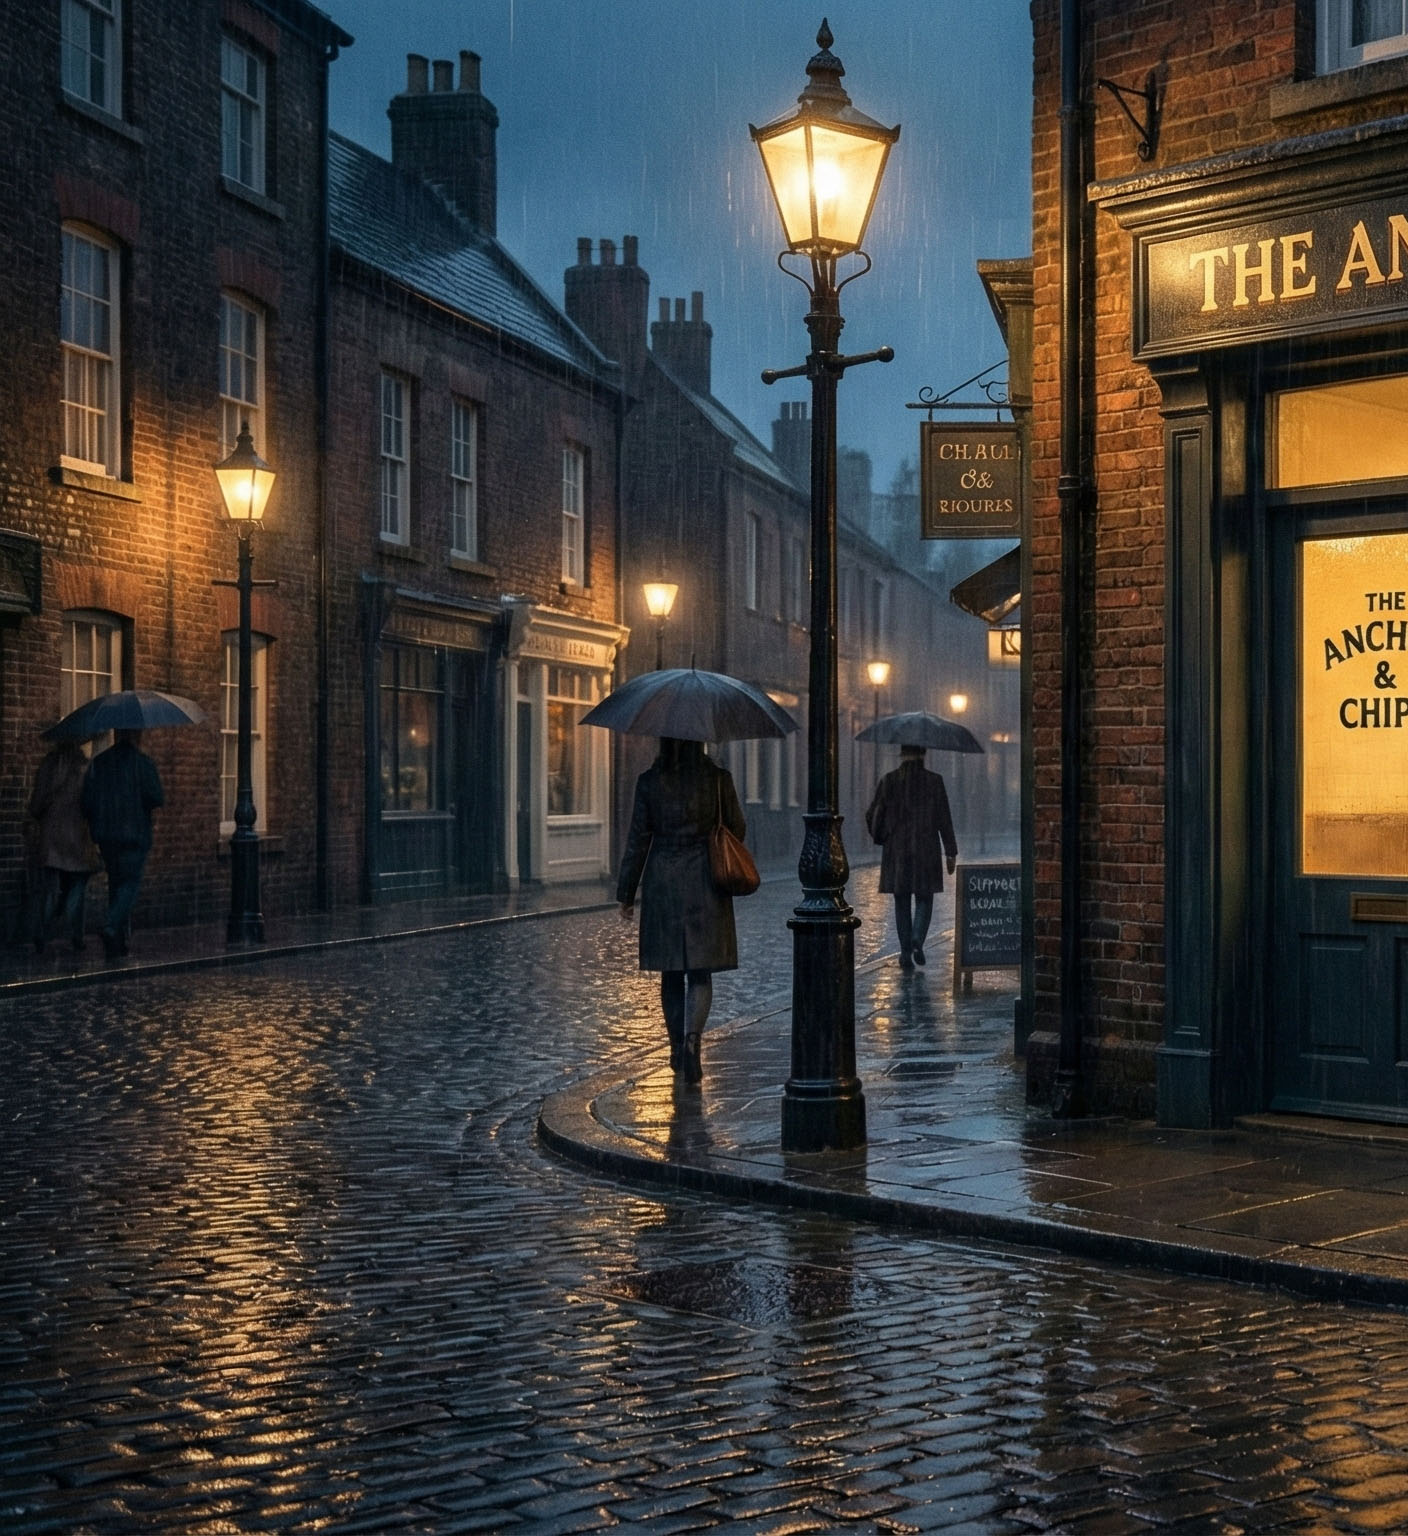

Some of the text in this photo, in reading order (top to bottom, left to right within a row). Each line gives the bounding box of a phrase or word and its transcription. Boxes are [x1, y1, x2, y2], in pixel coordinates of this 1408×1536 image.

[1190, 230, 1317, 312] THE
[1364, 591, 1406, 613] THE
[1373, 660, 1398, 690] &
